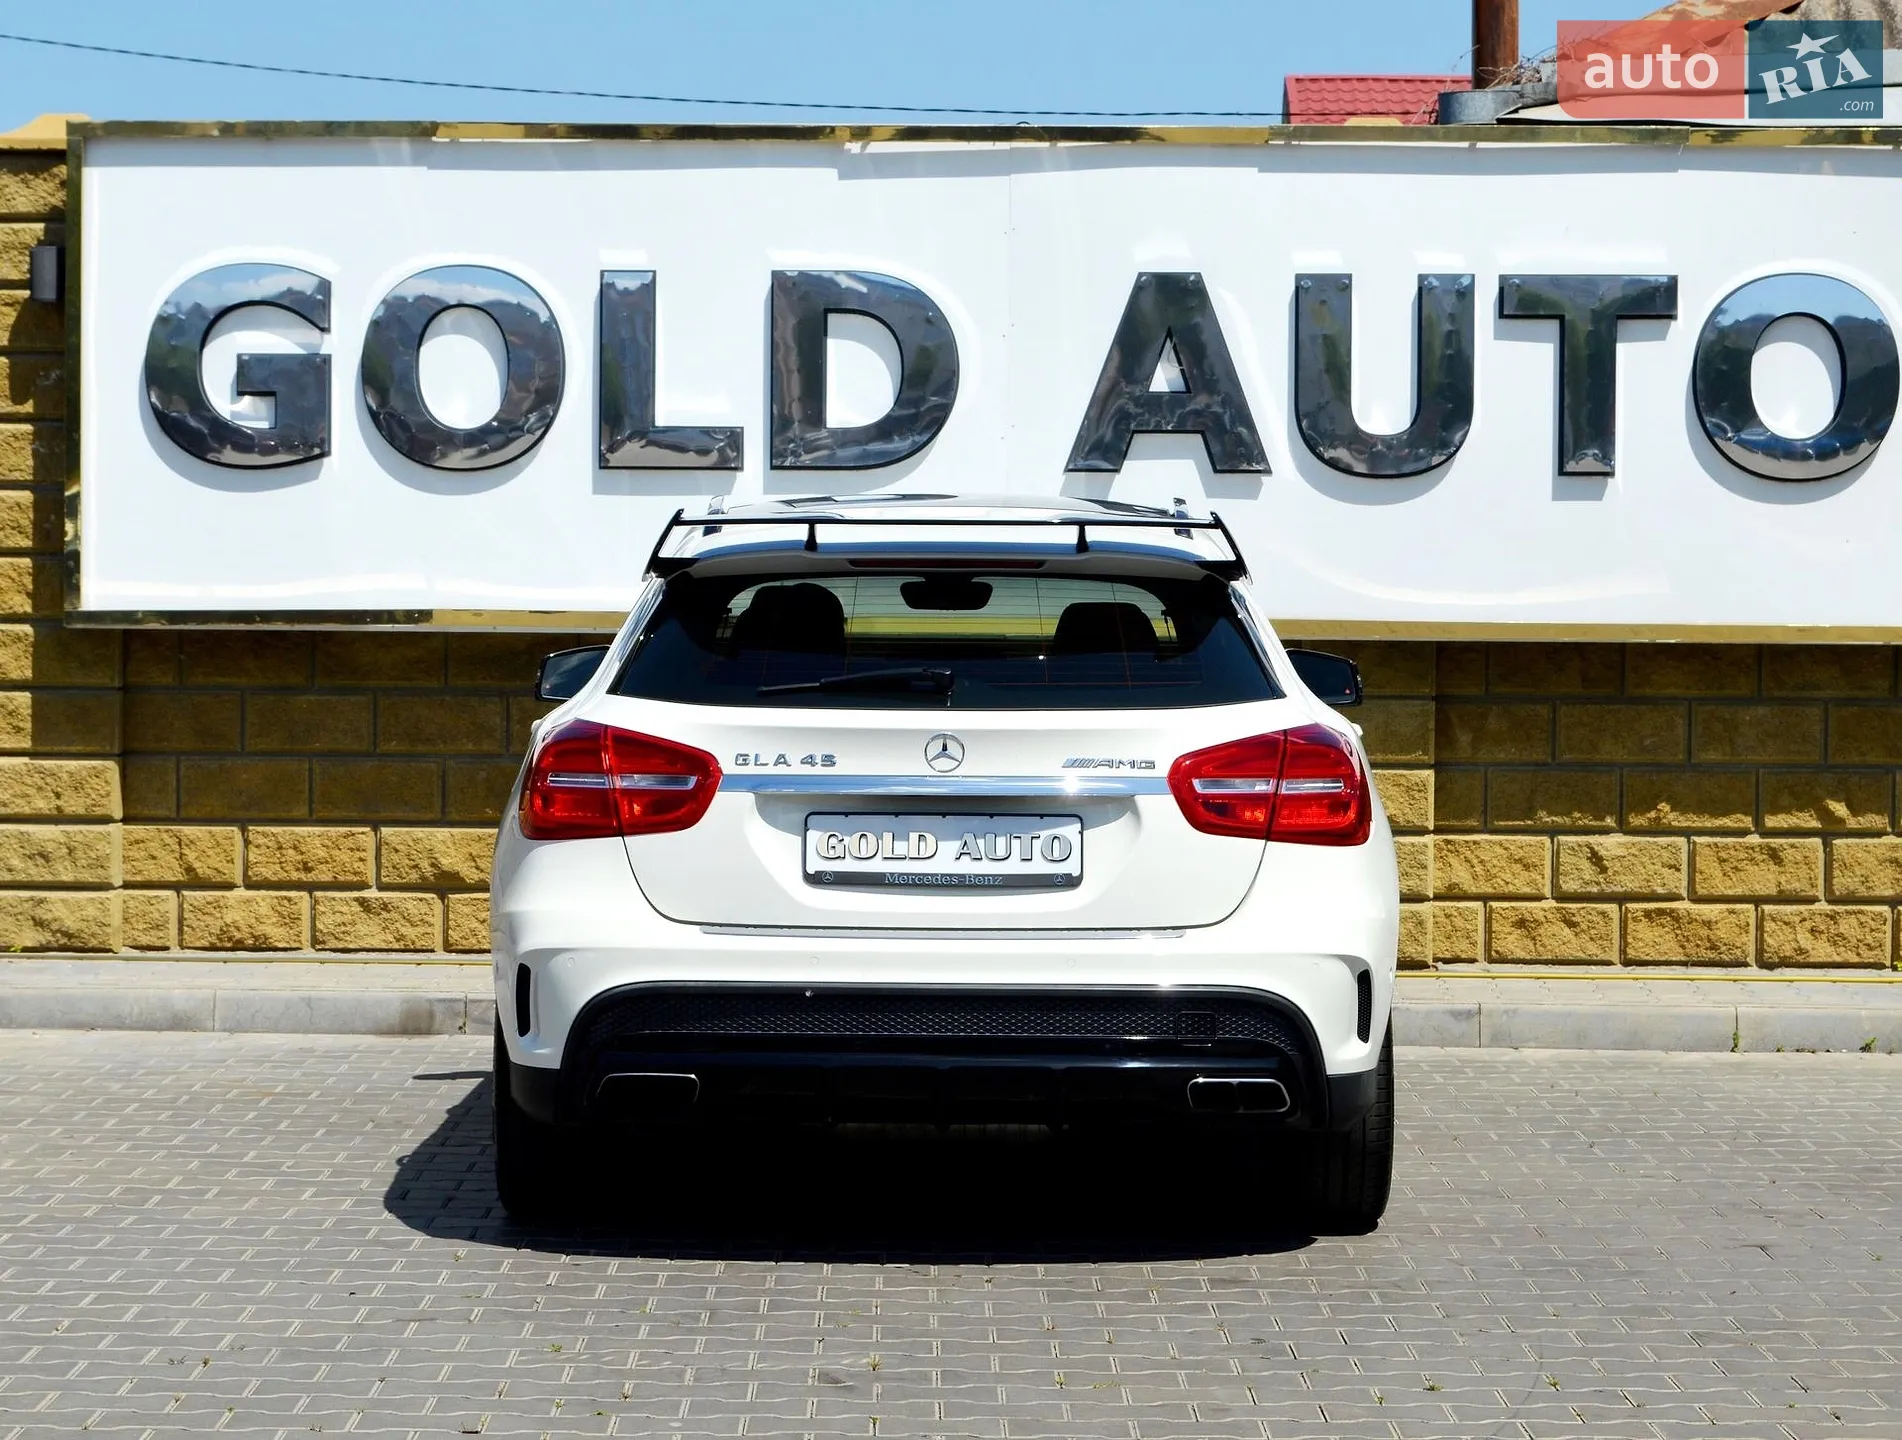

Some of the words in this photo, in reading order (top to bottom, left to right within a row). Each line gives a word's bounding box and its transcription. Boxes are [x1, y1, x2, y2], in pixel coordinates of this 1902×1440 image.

[145, 263, 960, 470] GOLD
[1063, 272, 1900, 482] AUTO
[734, 753, 792, 767] GLA
[800, 754, 837, 767] 45
[1096, 758, 1156, 770] AMG
[816, 832, 938, 861] GOLD
[954, 833, 1073, 862] AUTO
[884, 872, 1003, 886] Mercedes-Benz
